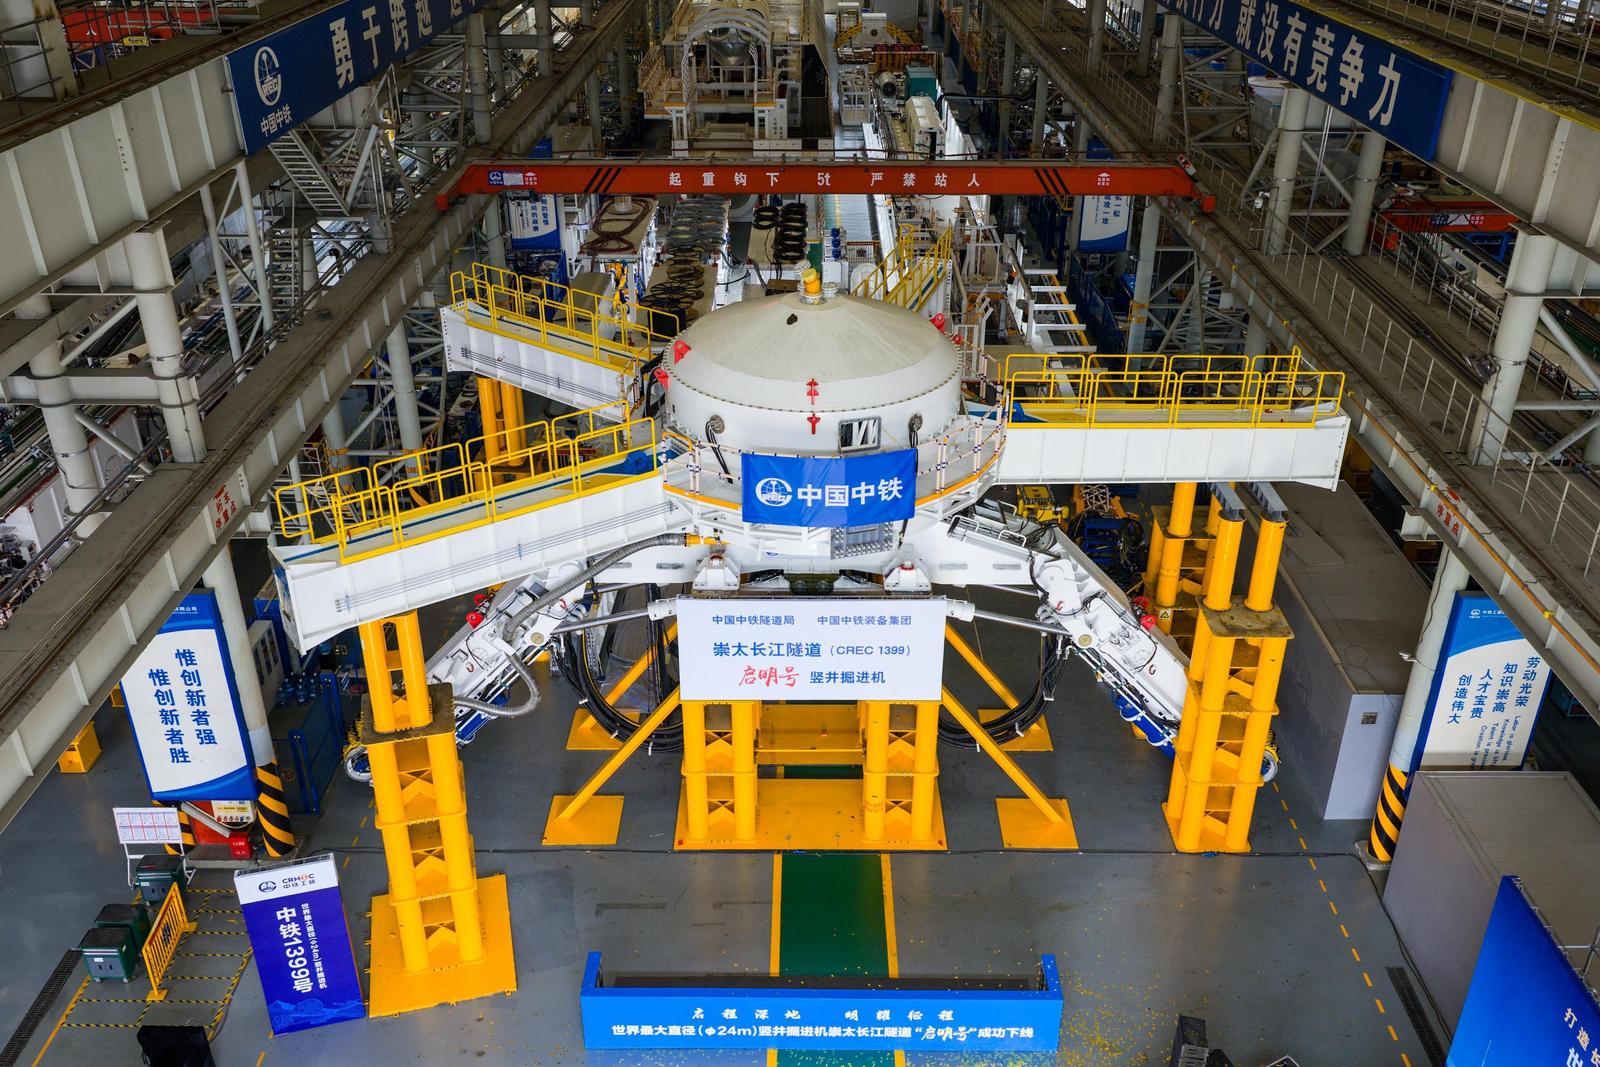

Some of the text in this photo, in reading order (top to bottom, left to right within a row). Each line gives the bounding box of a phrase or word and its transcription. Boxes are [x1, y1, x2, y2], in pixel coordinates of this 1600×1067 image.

[260, 103, 293, 138] 中国中铁
[669, 172, 981, 187] 起重钩下 5t 严禁站人
[797, 477, 904, 508] 中国中铁
[712, 614, 912, 626] 中国中铁隧道局 中国中铁装备集团
[713, 642, 822, 658] 崇太长江隧道
[174, 648, 218, 746] 惟创新者强
[738, 665, 886, 687] 启明号 竖井掘进机
[1447, 674, 1473, 724] 创造伟大
[1470, 668, 1494, 719] 人才宝贵
[1492, 662, 1518, 713] 知识崇高
[1514, 656, 1541, 708] 劳动光荣
[148, 667, 192, 764] 惟创新者胜
[276, 906, 314, 993] 中铁1399号
